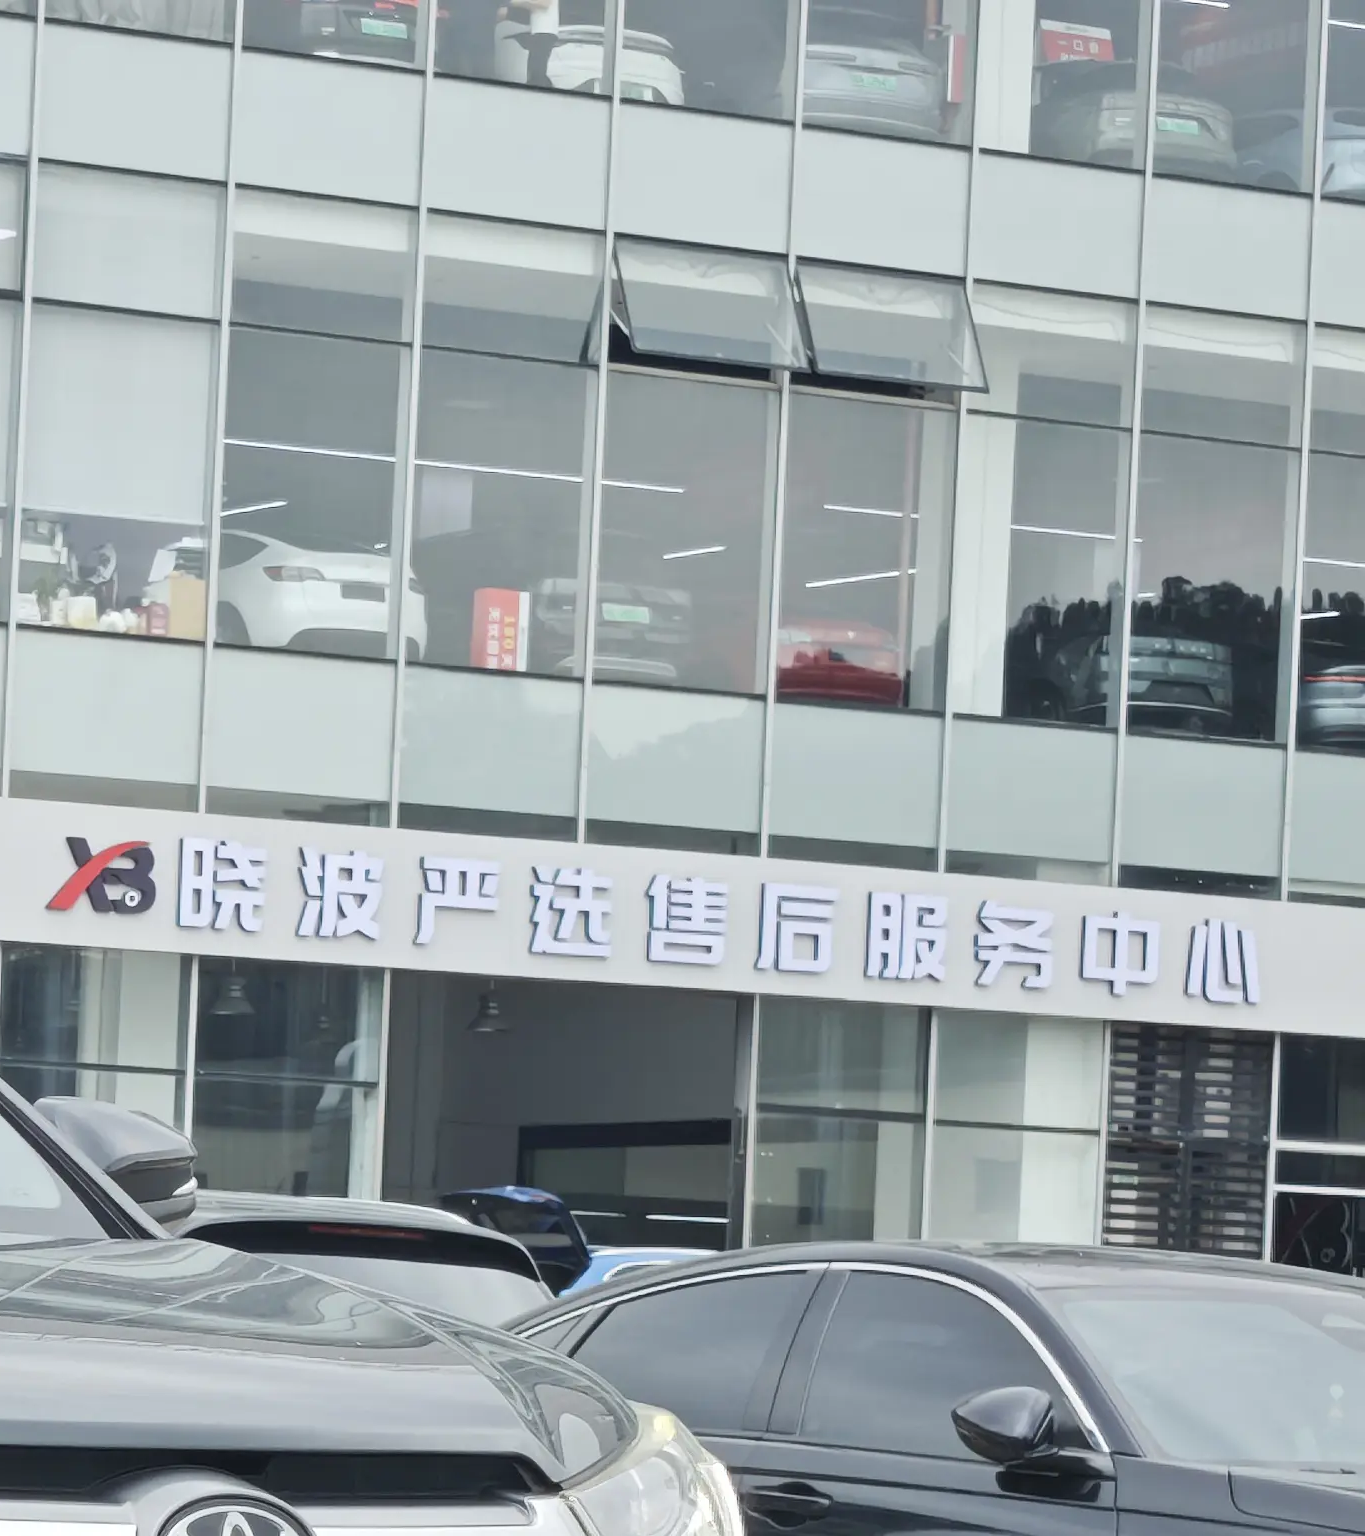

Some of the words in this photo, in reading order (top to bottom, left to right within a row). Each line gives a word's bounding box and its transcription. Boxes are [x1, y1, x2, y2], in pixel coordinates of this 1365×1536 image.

[177, 836, 1261, 1005] 晓波严选售后服务中心
